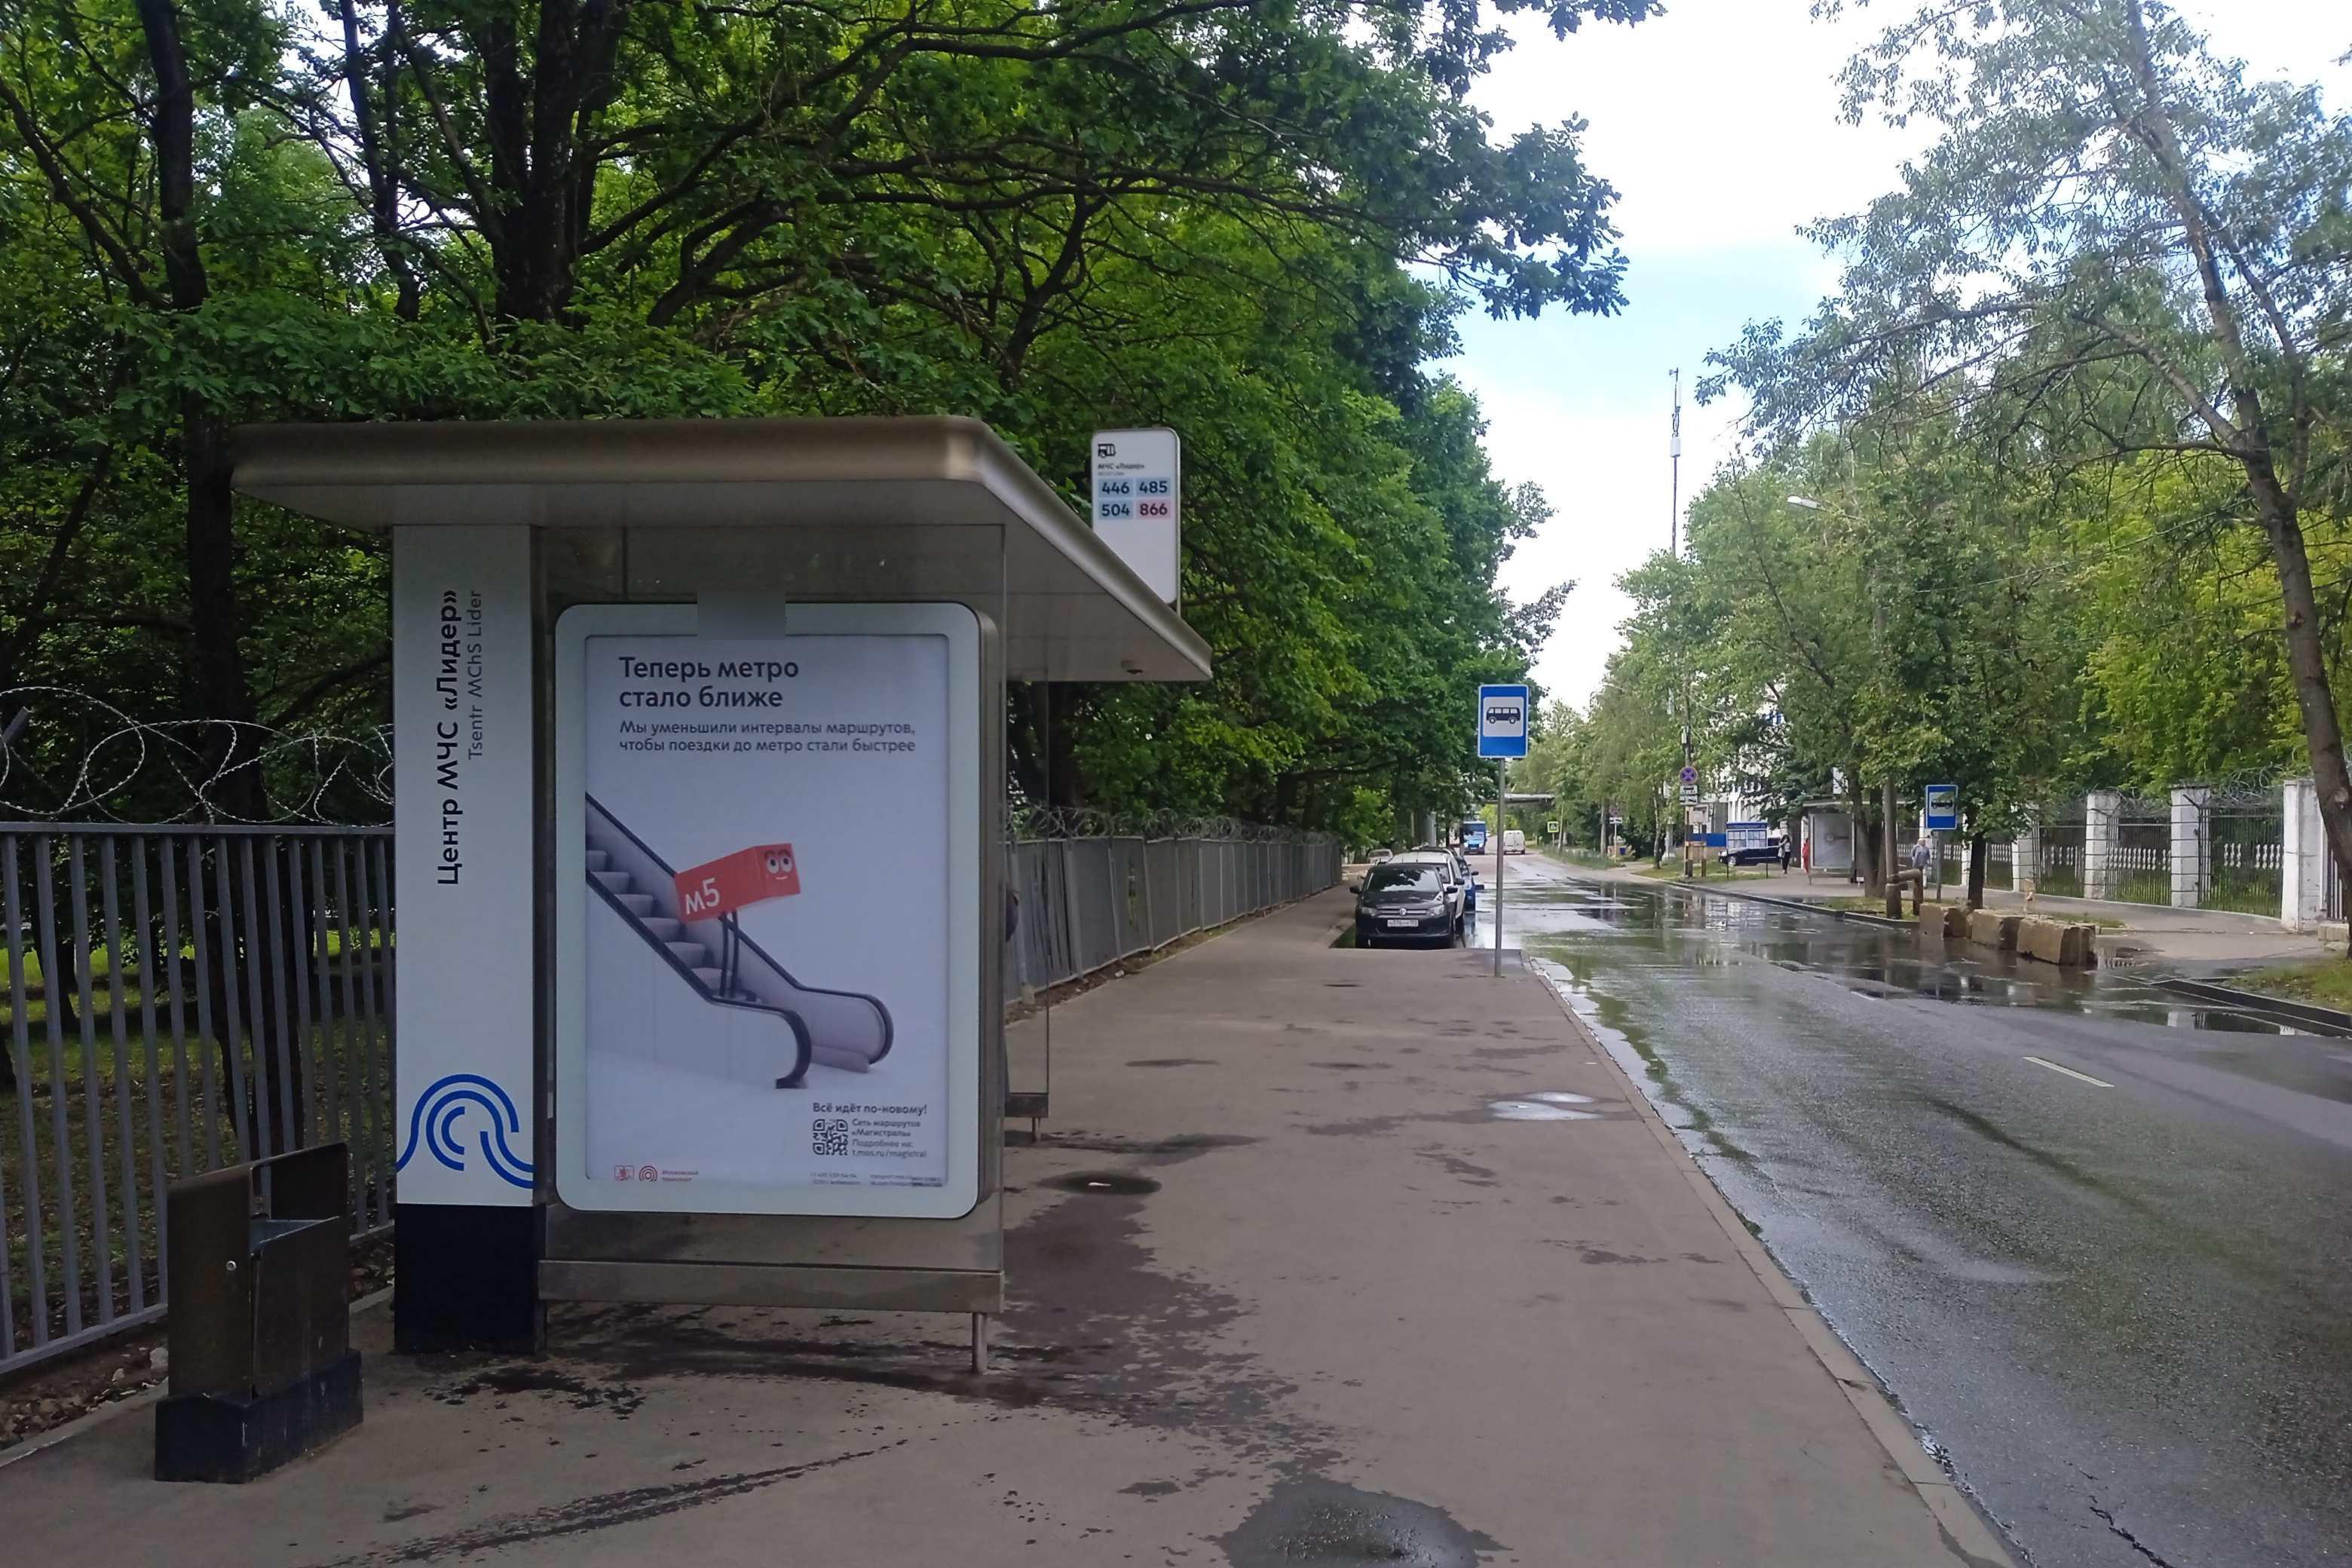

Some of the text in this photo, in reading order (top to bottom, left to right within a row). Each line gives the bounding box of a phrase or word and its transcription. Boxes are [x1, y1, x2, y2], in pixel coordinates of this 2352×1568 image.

[1101, 481, 1168, 495] 446 485
[1101, 503, 1168, 516] 504 866
[467, 590, 482, 760] Tsentr MChS Lider
[619, 657, 798, 682] Теперь метро
[619, 685, 782, 707] стало ближе
[436, 590, 463, 884] Центр МЧС «Лидер»
[620, 721, 915, 737] Мы уменьшили интервалы маршрутов,
[620, 738, 916, 754] чтобы поездки до метро стали быстрее
[813, 1102, 927, 1116] Всё идёт по-новому!
